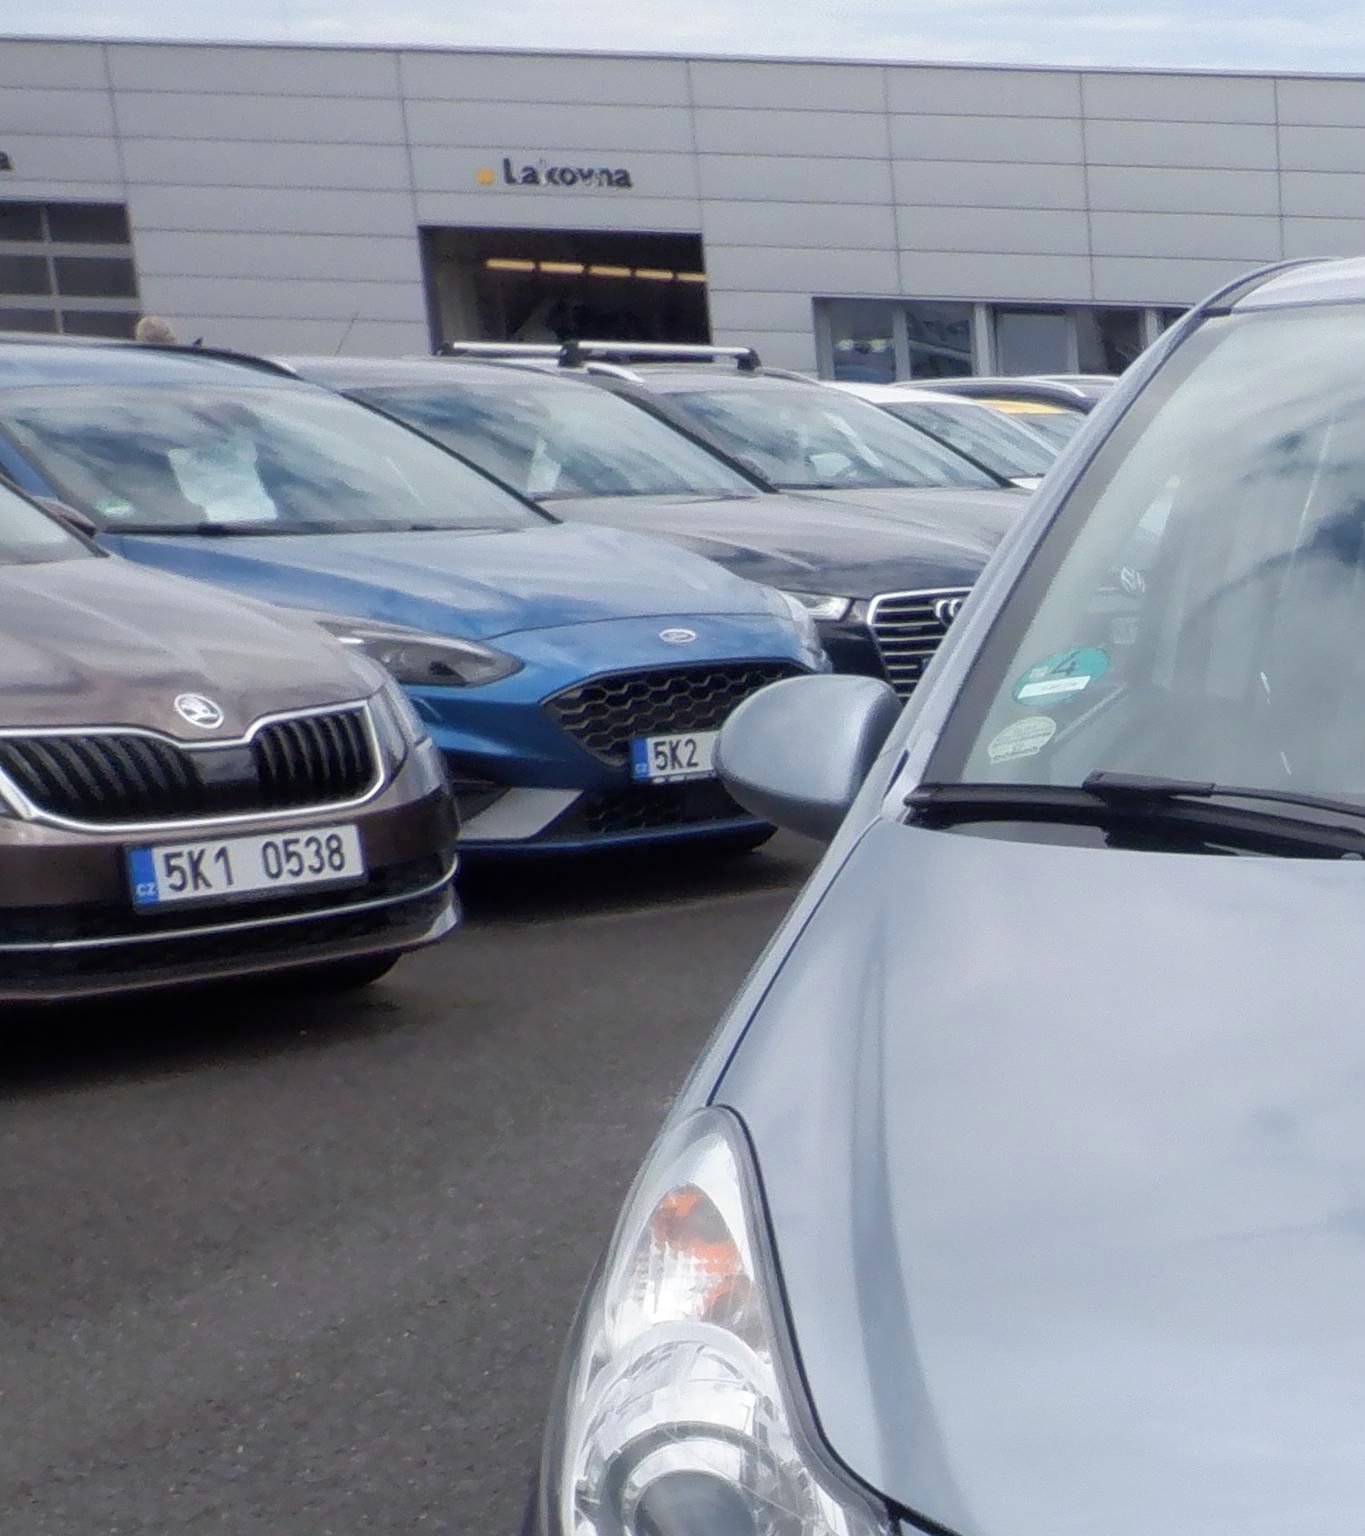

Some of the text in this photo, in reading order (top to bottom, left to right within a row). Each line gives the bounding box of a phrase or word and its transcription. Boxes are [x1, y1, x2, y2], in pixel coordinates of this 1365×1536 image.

[653, 738, 699, 771] 5K2
[164, 833, 346, 892] 5K1 0538
[135, 883, 157, 896] CZ
